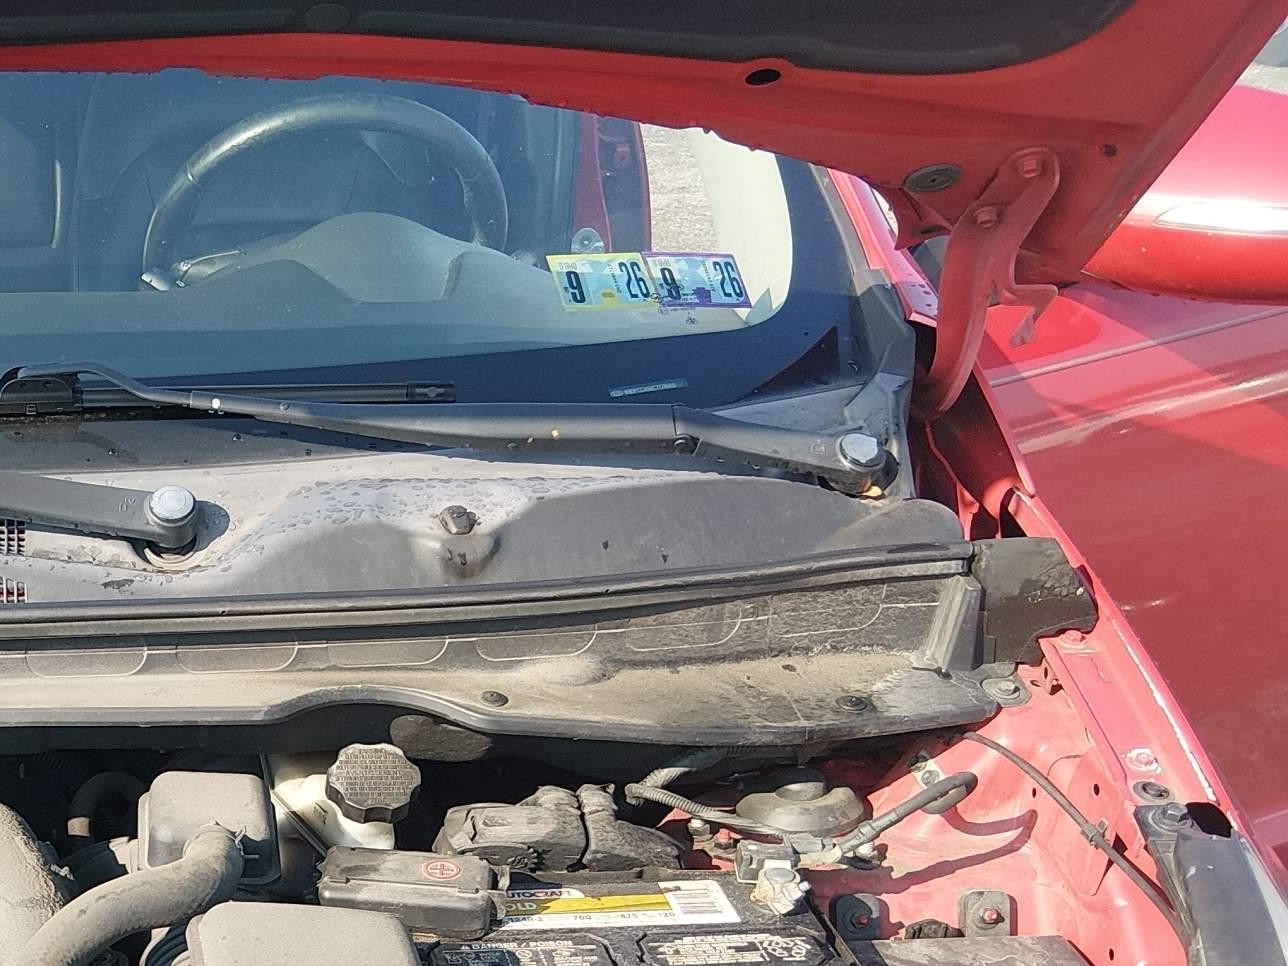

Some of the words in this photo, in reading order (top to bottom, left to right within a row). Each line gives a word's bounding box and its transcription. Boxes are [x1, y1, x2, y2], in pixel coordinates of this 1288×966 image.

[565, 270, 586, 304] 9
[619, 261, 650, 299] 26
[659, 267, 682, 301] 9
[713, 260, 744, 298] 26
[505, 902, 537, 911] OLD
[472, 941, 518, 950] DANGER
[529, 940, 573, 948] POISON
